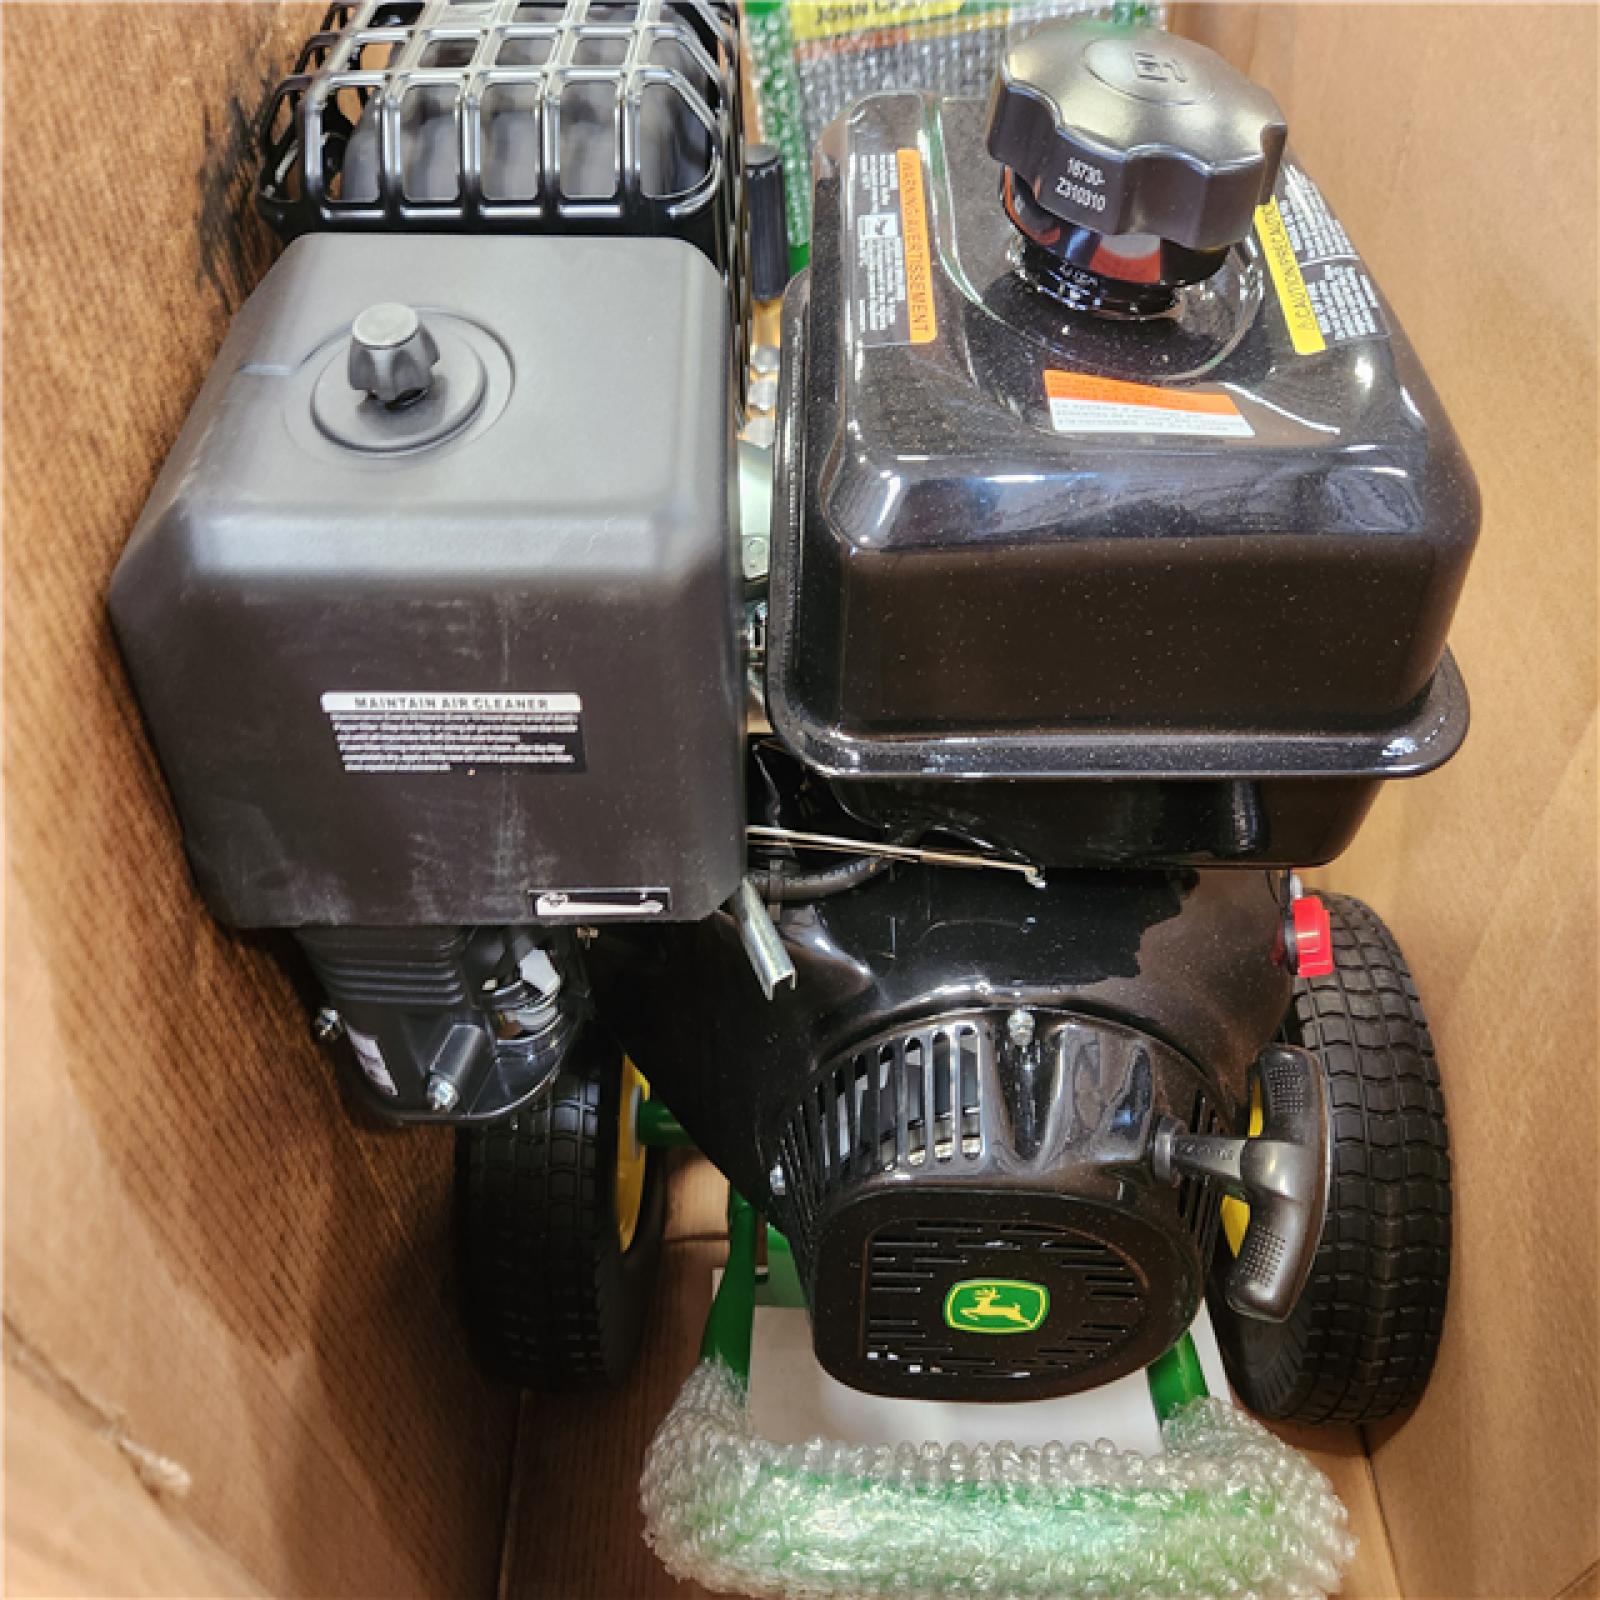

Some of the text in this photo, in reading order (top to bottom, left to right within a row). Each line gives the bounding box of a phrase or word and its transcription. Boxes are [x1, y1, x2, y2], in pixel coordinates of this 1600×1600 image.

[354, 696, 549, 709] MAINTAIN AIR CLEANER
